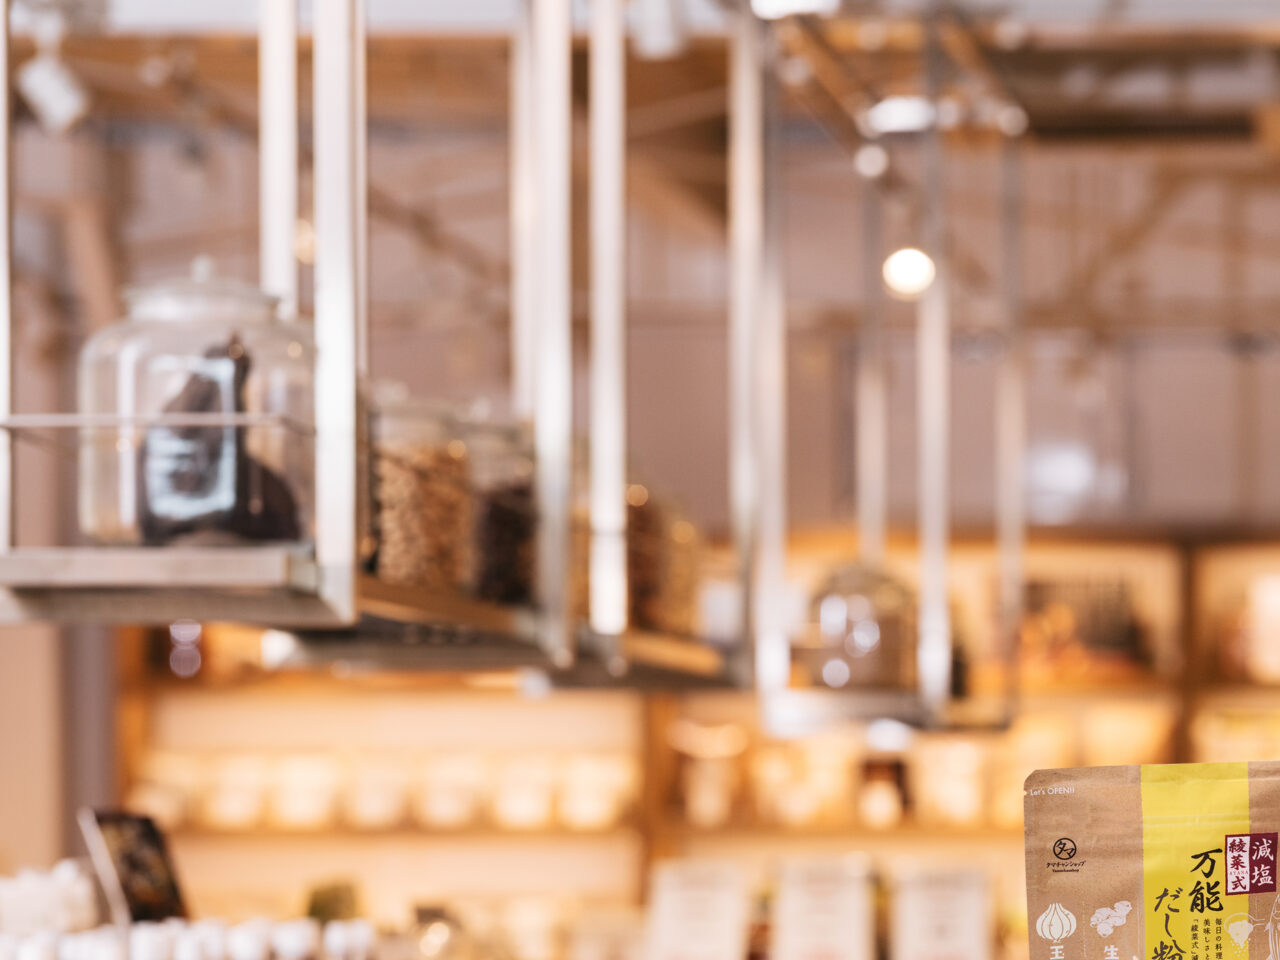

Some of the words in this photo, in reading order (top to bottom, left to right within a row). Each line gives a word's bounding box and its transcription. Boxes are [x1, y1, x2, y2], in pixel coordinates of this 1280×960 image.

[1030, 787, 1046, 796] Let's
[1188, 848, 1224, 914] 万能
[1228, 838, 1248, 891] 綾菜式
[1251, 838, 1274, 887] 減塩
